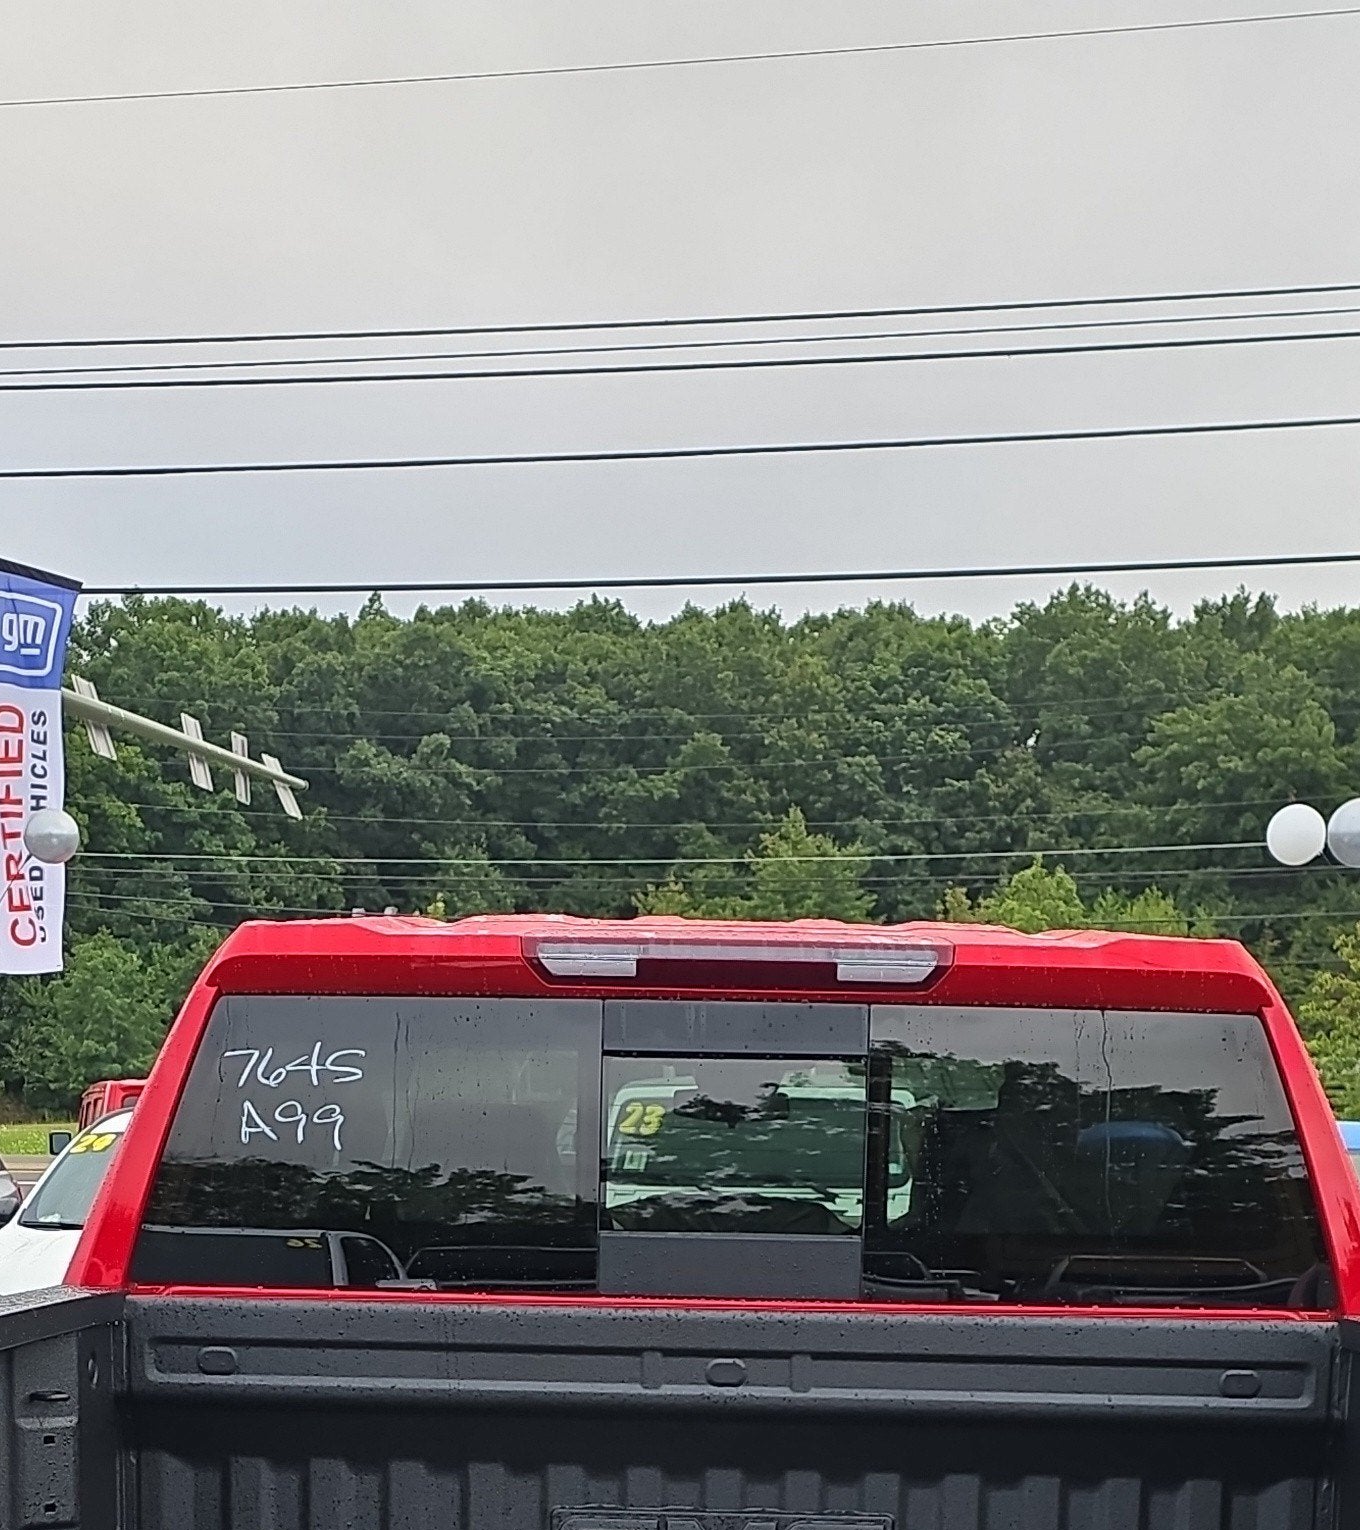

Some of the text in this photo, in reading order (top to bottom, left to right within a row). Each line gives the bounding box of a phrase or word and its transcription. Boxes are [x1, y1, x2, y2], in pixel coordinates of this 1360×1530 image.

[2, 613, 46, 655] gm
[30, 709, 48, 812] HICLES
[241, 1100, 345, 1151] A99
[619, 1102, 666, 1136] 23
